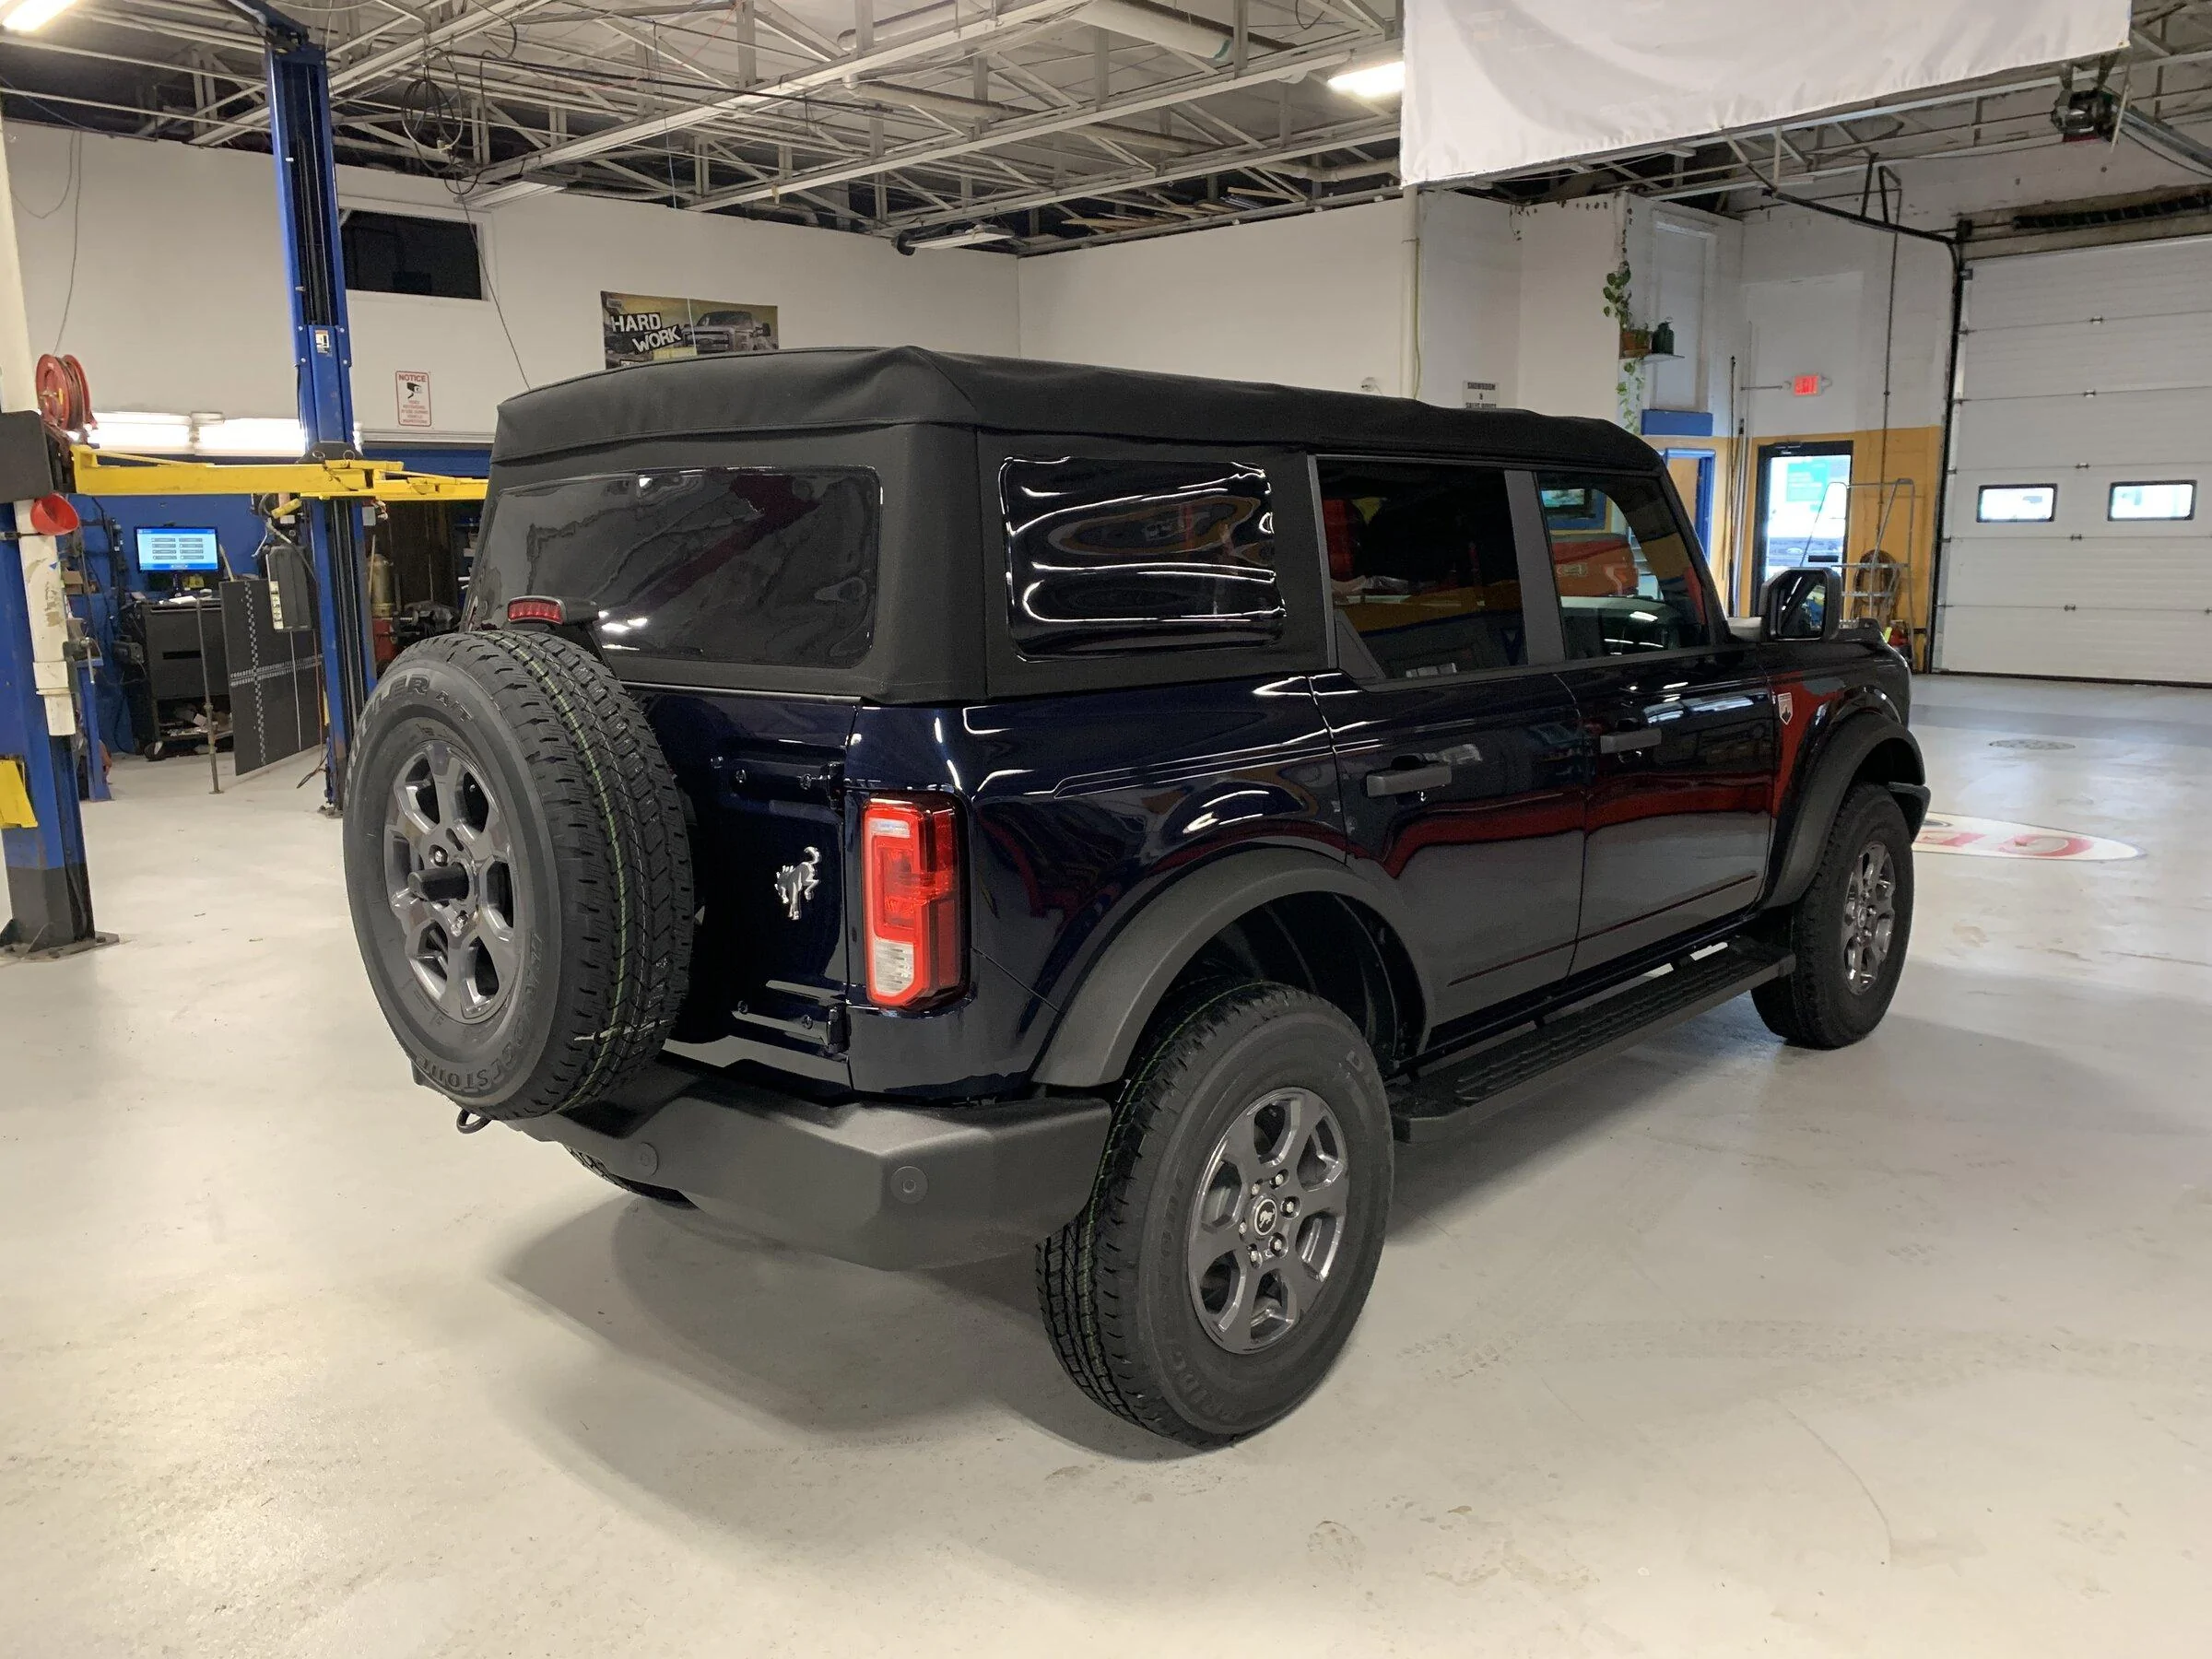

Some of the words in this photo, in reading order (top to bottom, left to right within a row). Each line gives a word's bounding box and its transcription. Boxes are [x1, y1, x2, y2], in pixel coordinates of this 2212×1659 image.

[611, 313, 662, 332] HARD
[632, 326, 681, 353] WORK
[398, 373, 427, 382] NOTICE
